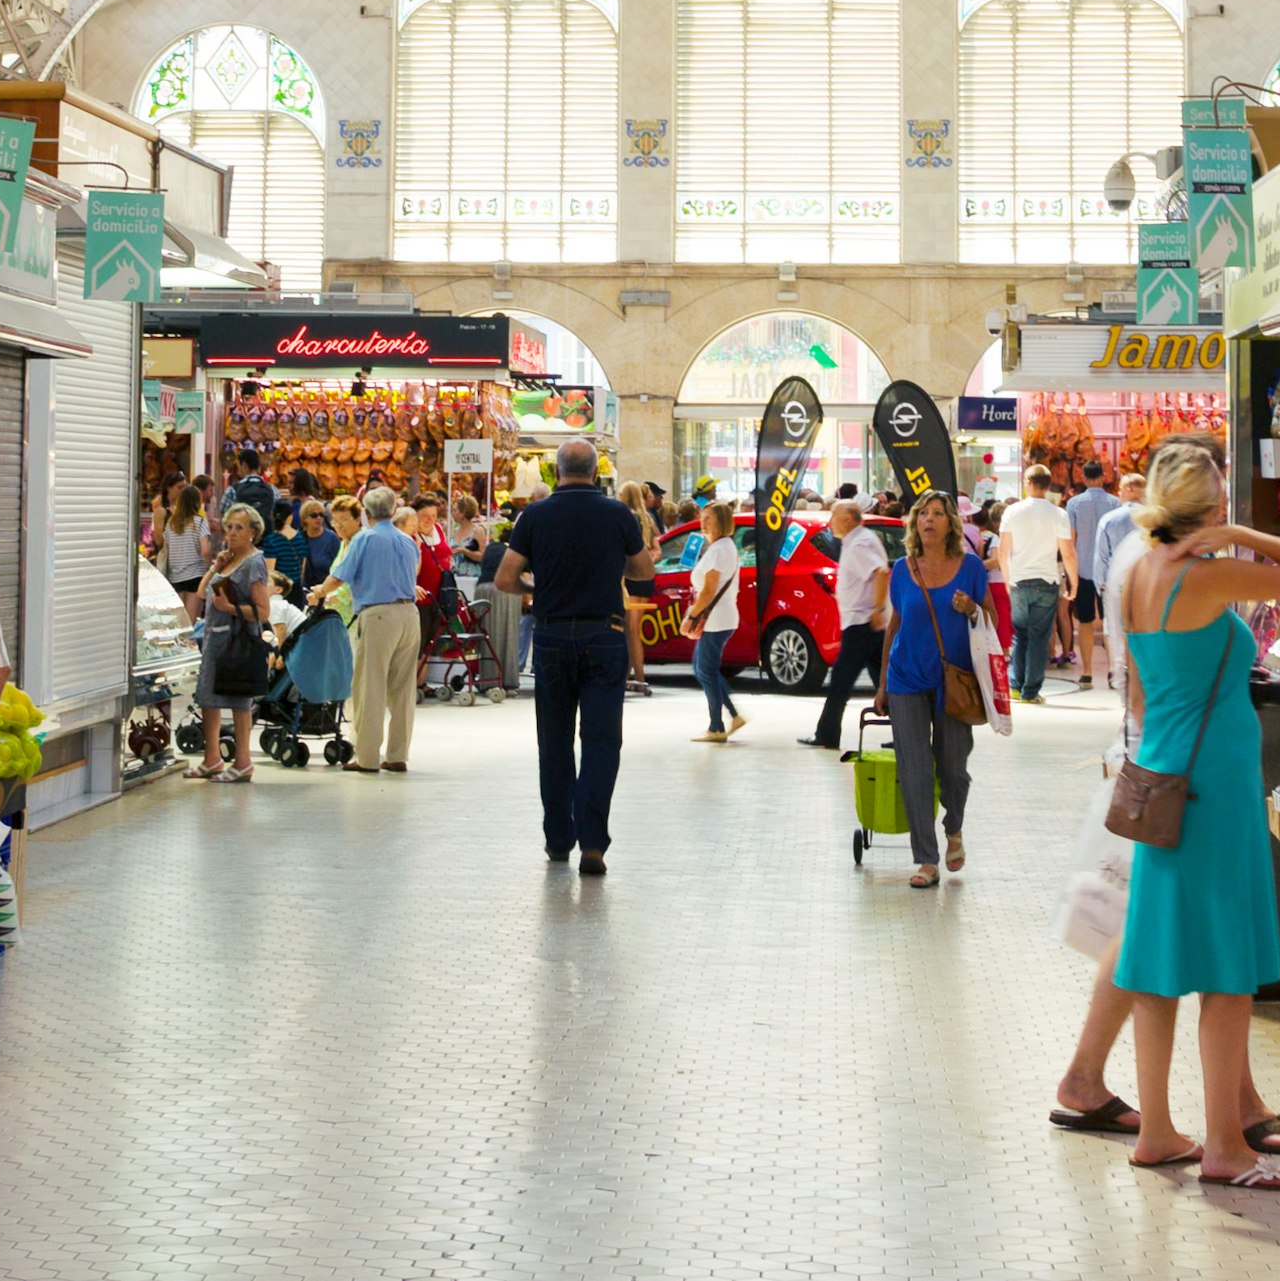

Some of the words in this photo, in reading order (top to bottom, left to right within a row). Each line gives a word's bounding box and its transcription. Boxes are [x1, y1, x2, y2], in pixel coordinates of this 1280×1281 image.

[8, 136, 19, 150] a
[1189, 142, 1238, 161] Servicio
[1239, 148, 1248, 162] a
[1191, 164, 1248, 182] domicilio
[92, 200, 149, 217] Servicio
[151, 206, 160, 218] a
[93, 218, 158, 234] domicilio
[1141, 231, 1186, 245] Servicio
[276, 325, 429, 356] charcutería
[765, 466, 798, 531] OPEL
